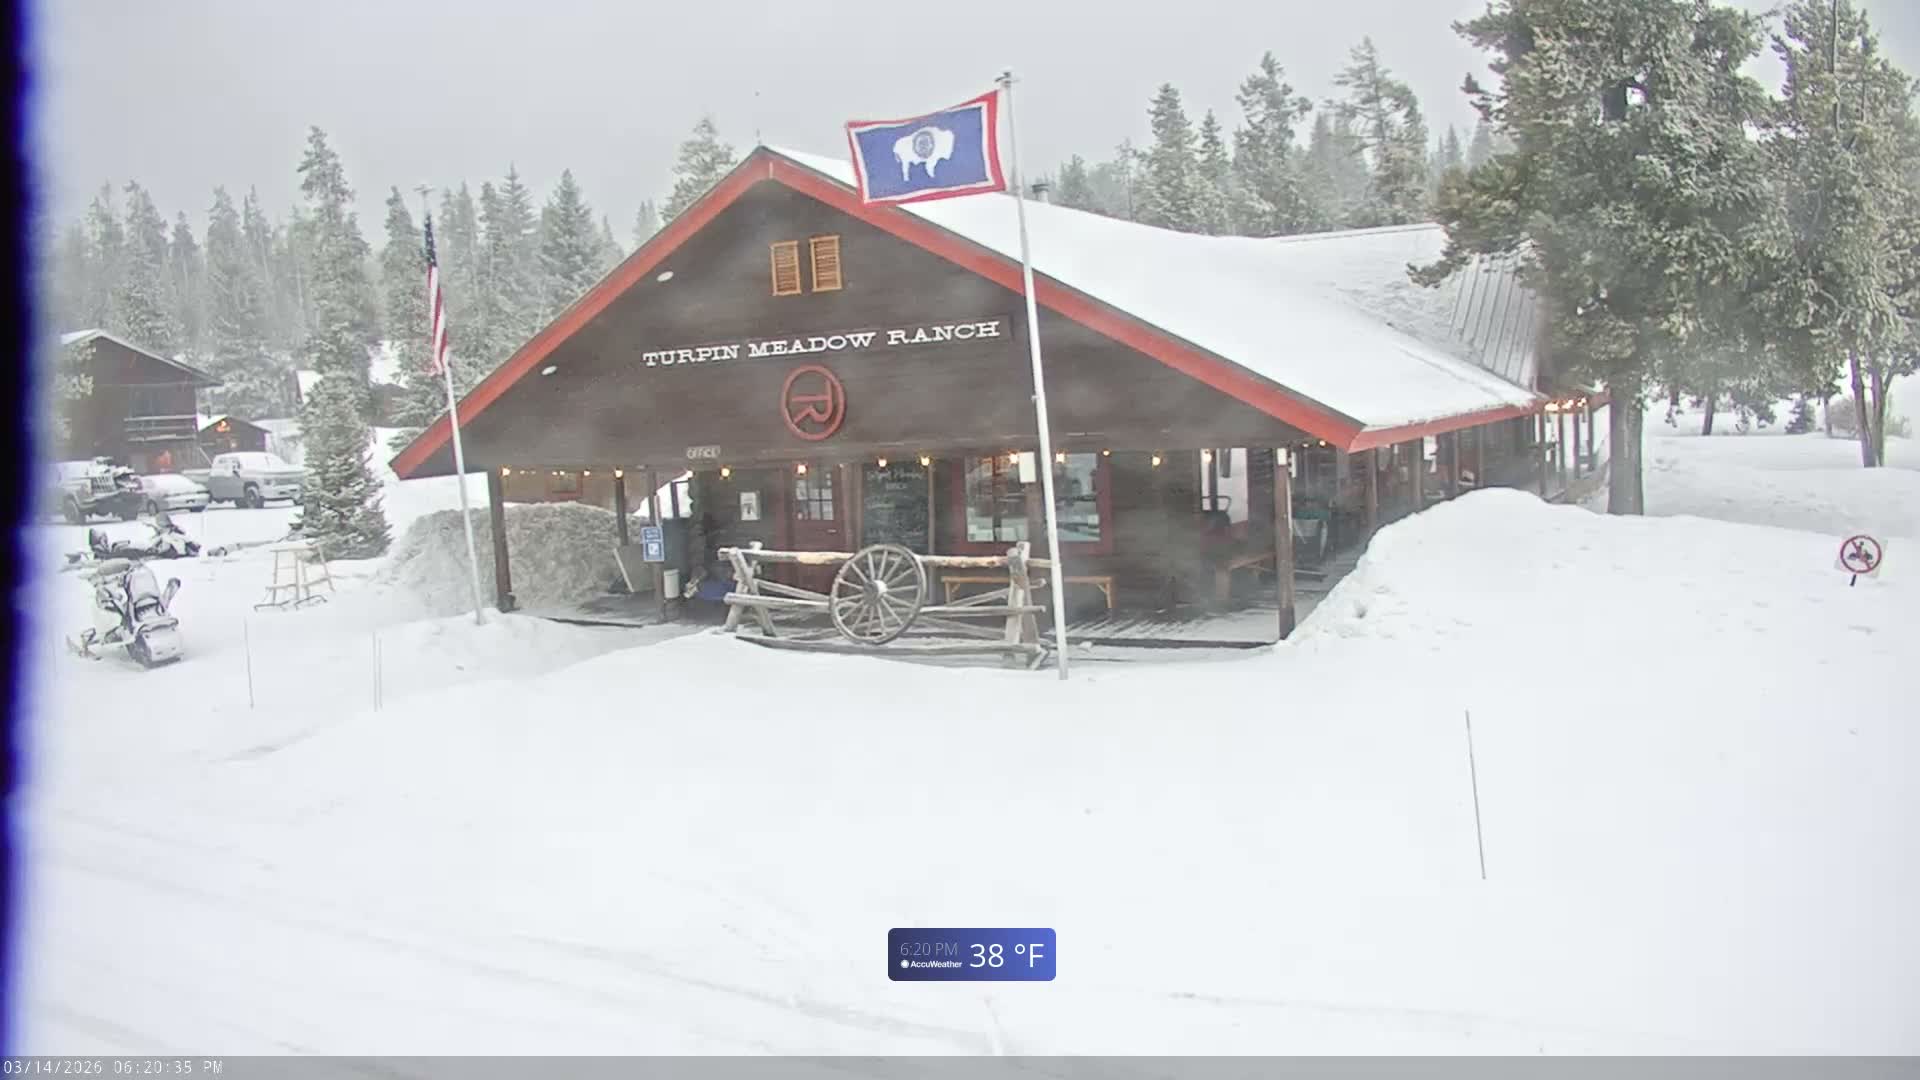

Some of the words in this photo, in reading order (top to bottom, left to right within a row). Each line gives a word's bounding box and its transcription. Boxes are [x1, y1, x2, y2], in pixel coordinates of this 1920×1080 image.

[642, 344, 740, 366] TURPIN
[748, 332, 876, 357] MEADOW
[887, 321, 1000, 345] RANCH
